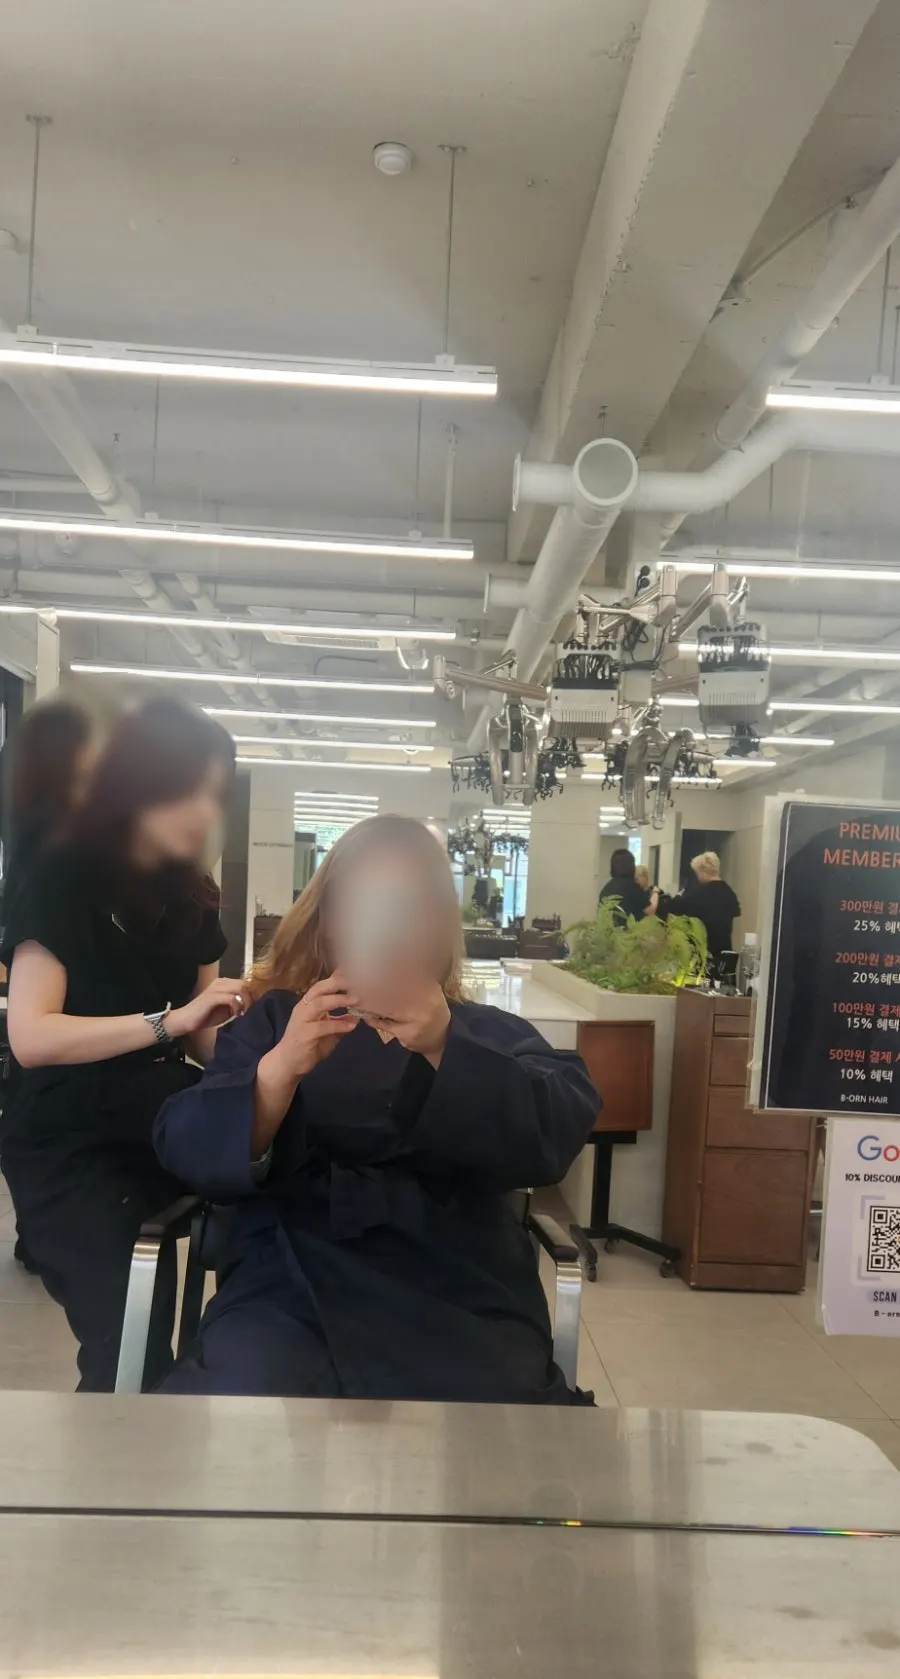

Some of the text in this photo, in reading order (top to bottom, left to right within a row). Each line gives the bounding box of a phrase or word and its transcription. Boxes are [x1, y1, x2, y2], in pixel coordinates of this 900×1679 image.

[823, 847, 900, 868] MEMBER
[840, 900, 900, 915] 300만원 결
[853, 919, 881, 932] 25%
[835, 952, 880, 967] 200만원
[832, 1002, 875, 1016] 100만원
[846, 1017, 900, 1032] 15% 혜택
[829, 1048, 865, 1063] 50만원
[870, 1050, 893, 1064] 결제
[840, 1068, 894, 1084] 10% 혜택
[868, 1095, 889, 1105] HAIR
[845, 1172, 861, 1182] 10%
[873, 1290, 897, 1303] SCAN
